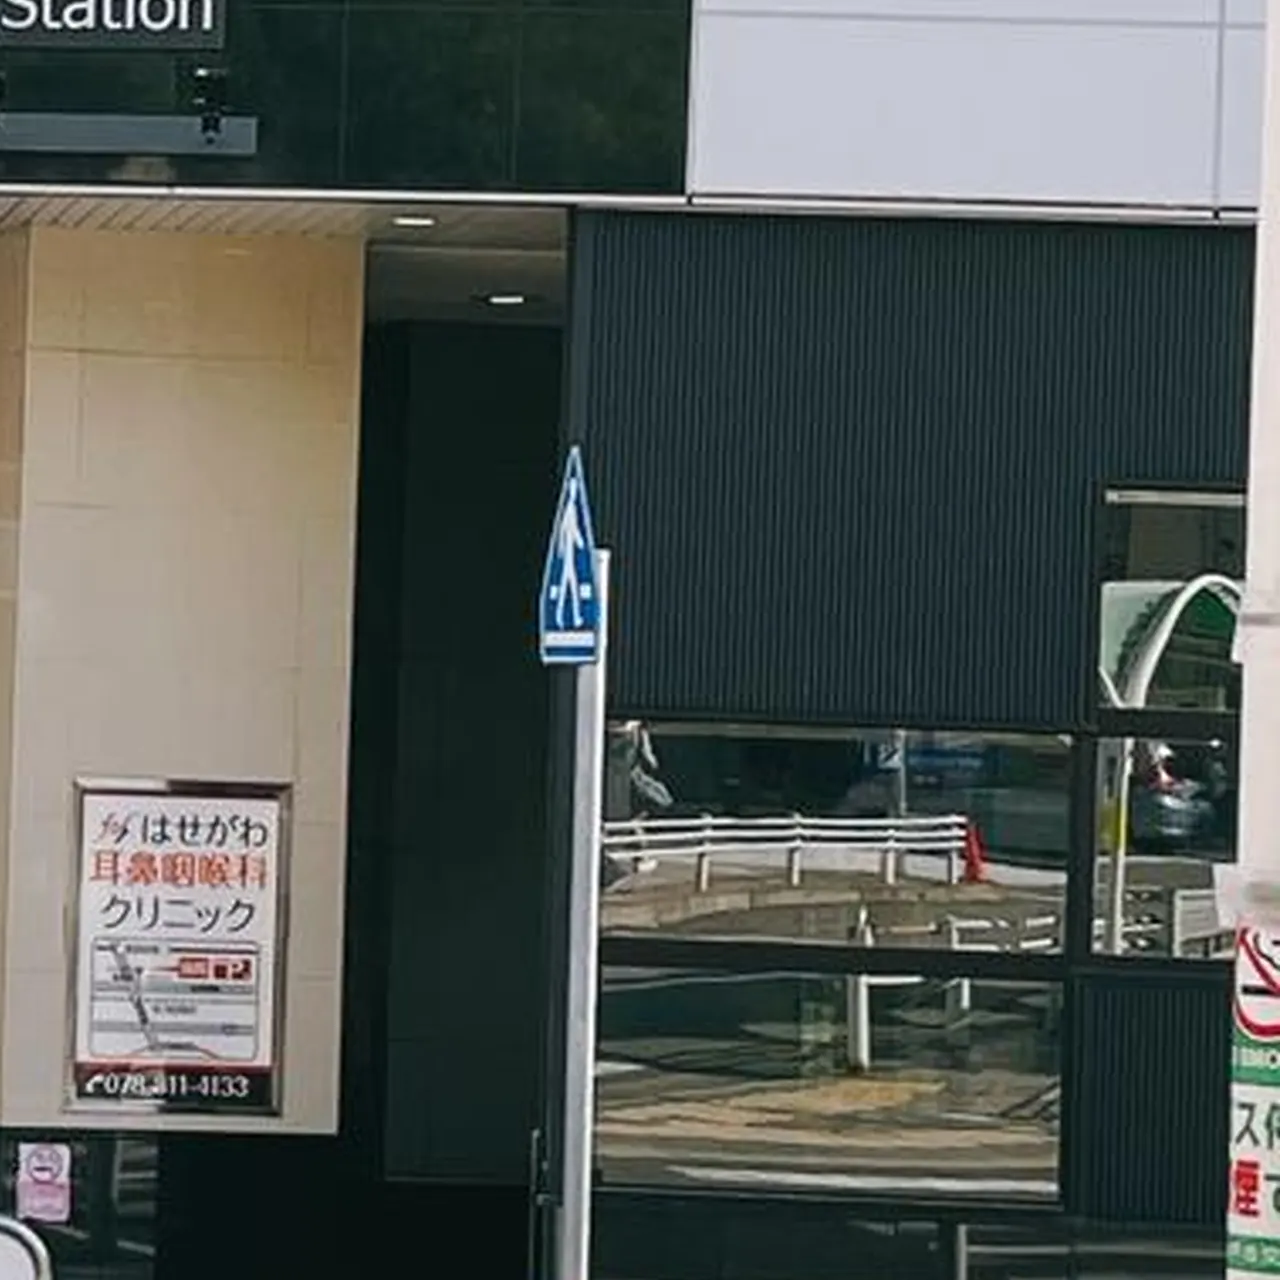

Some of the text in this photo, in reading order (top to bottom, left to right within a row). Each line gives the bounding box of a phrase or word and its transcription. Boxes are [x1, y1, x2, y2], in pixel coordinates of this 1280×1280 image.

[142, 814, 268, 847] はせがわ
[89, 849, 267, 889] 耳鼻咽喉科
[100, 894, 256, 934] クリニック
